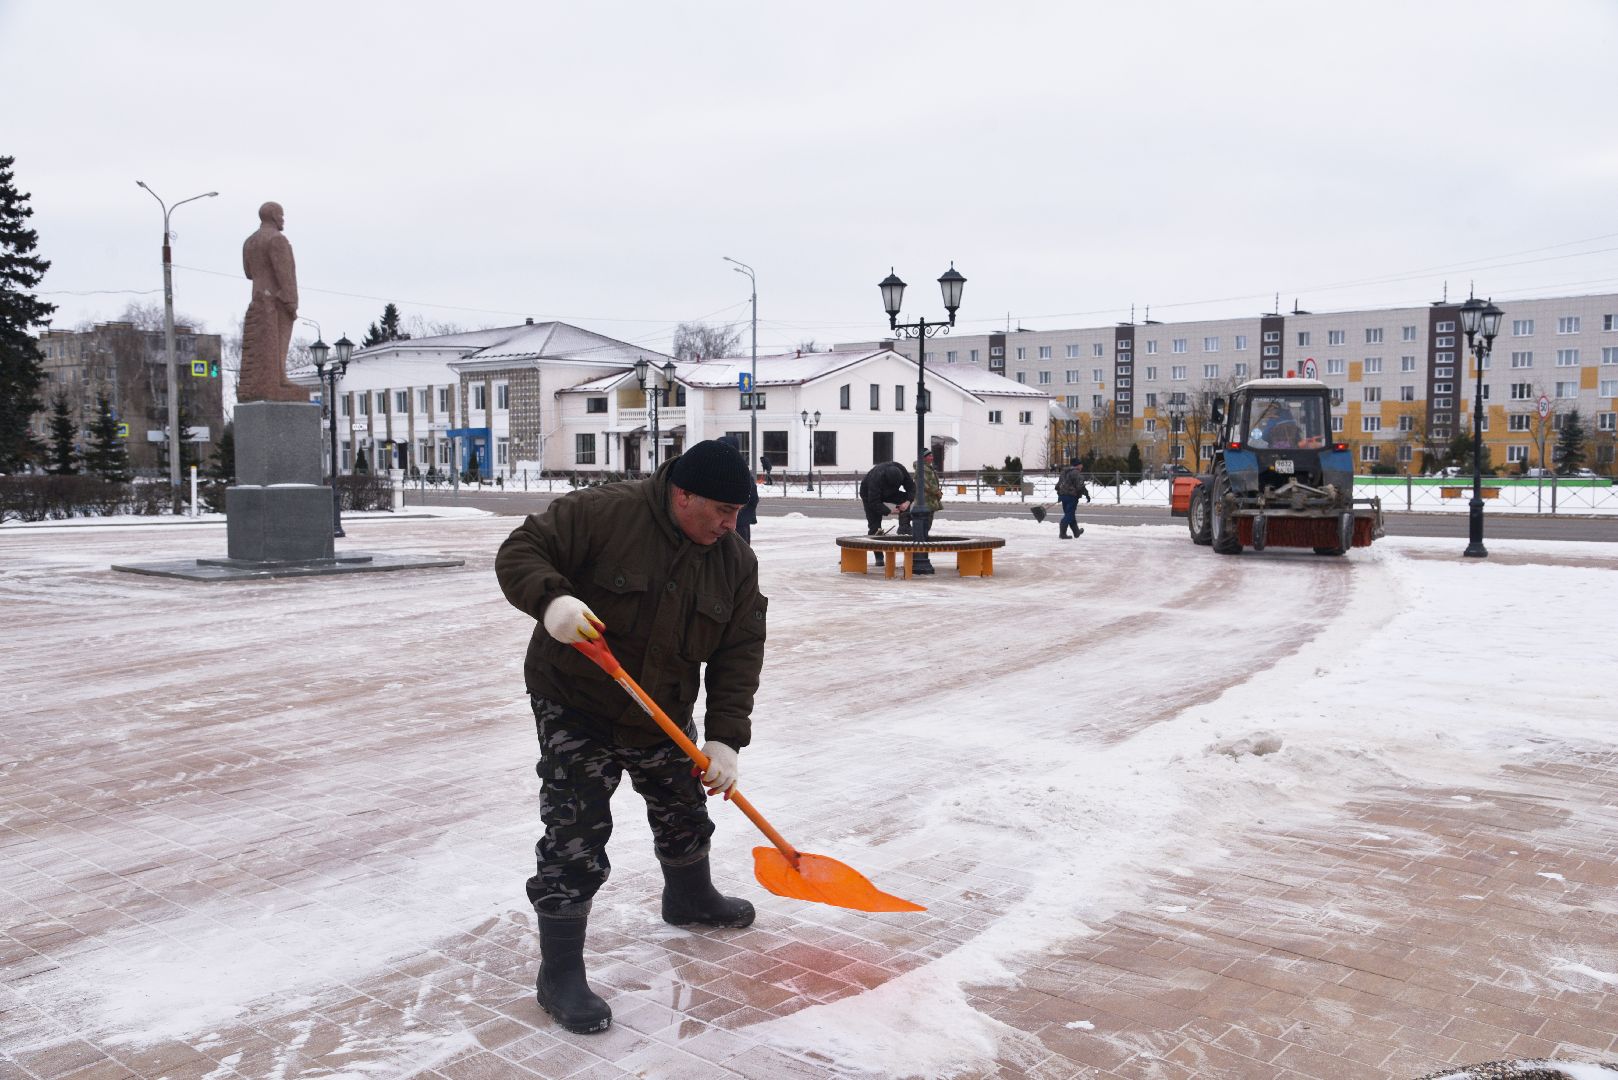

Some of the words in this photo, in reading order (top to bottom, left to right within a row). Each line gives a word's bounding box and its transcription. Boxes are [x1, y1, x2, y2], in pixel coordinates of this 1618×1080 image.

[1306, 367, 1315, 378] 50
[1540, 401, 1548, 412] 50
[352, 423, 368, 431] OZON
